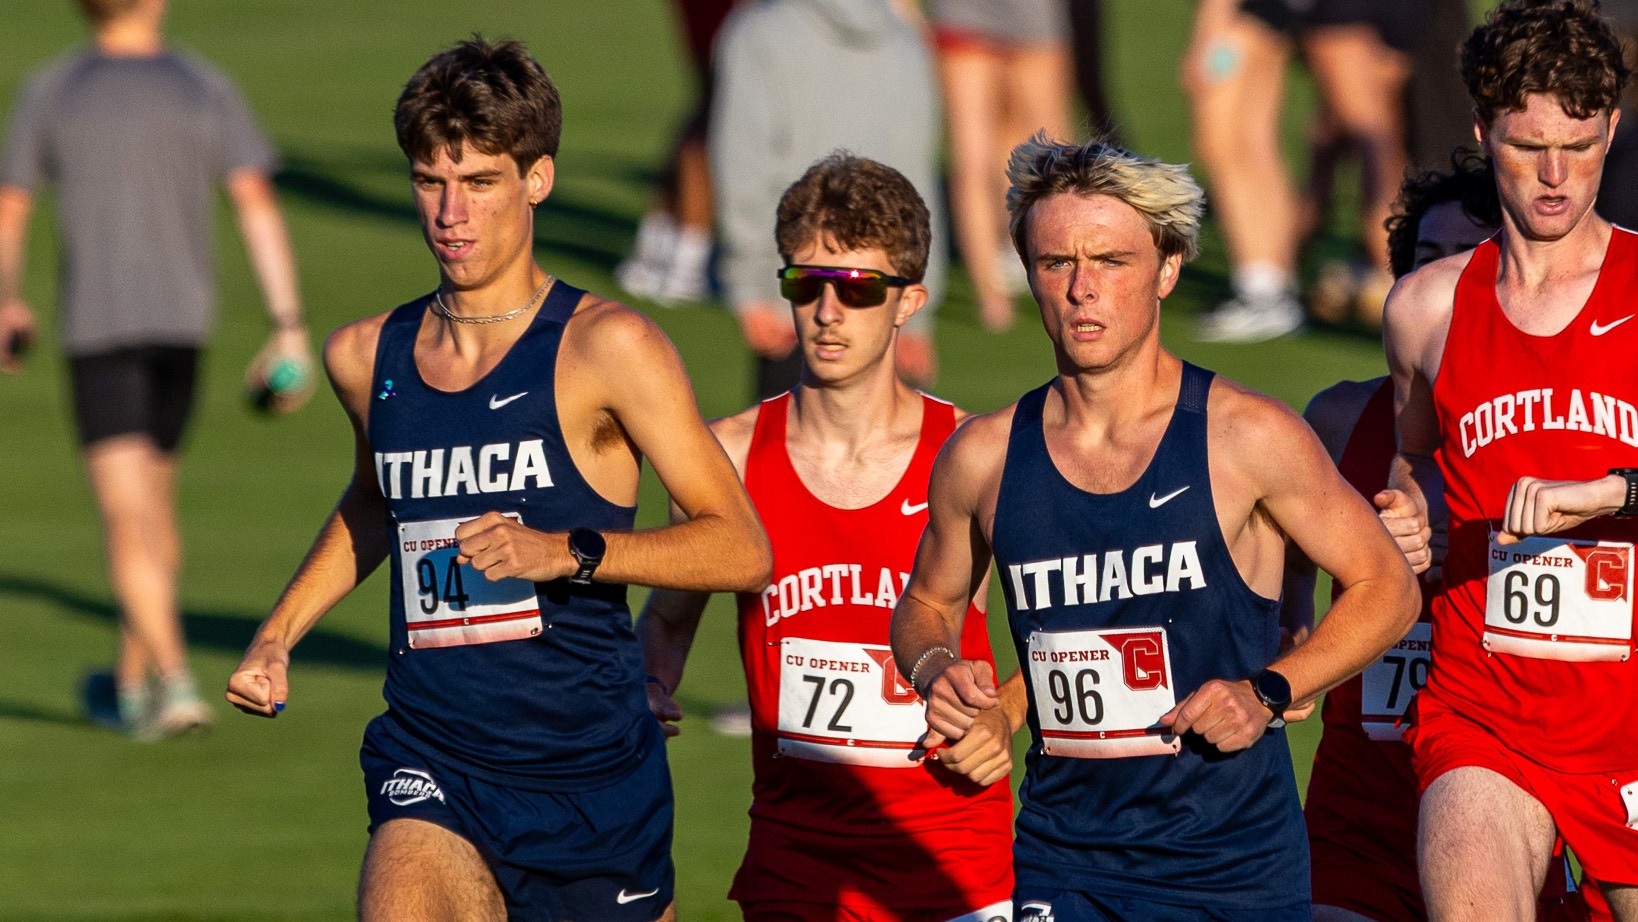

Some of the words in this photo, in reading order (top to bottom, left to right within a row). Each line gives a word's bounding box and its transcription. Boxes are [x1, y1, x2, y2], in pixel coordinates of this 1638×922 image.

[1459, 388, 1638, 458] CORTLAND
[374, 439, 554, 499] ITHACA
[403, 541, 417, 552] CU
[420, 538, 460, 551] OPENE
[1491, 548, 1507, 561] CU
[1513, 551, 1573, 568] OPENER
[417, 557, 469, 614] 94
[1008, 540, 1207, 610] ITHACA
[1503, 570, 1561, 627] 69
[786, 655, 804, 667] CU
[810, 658, 870, 673] OPENER
[1031, 650, 1047, 662] CU
[1051, 649, 1110, 662] OPENER
[1392, 640, 1431, 651] PEN
[802, 674, 855, 733] 72
[1048, 668, 1104, 725] 96
[1383, 656, 1430, 709] 70
[380, 778, 446, 805] ITHACA
